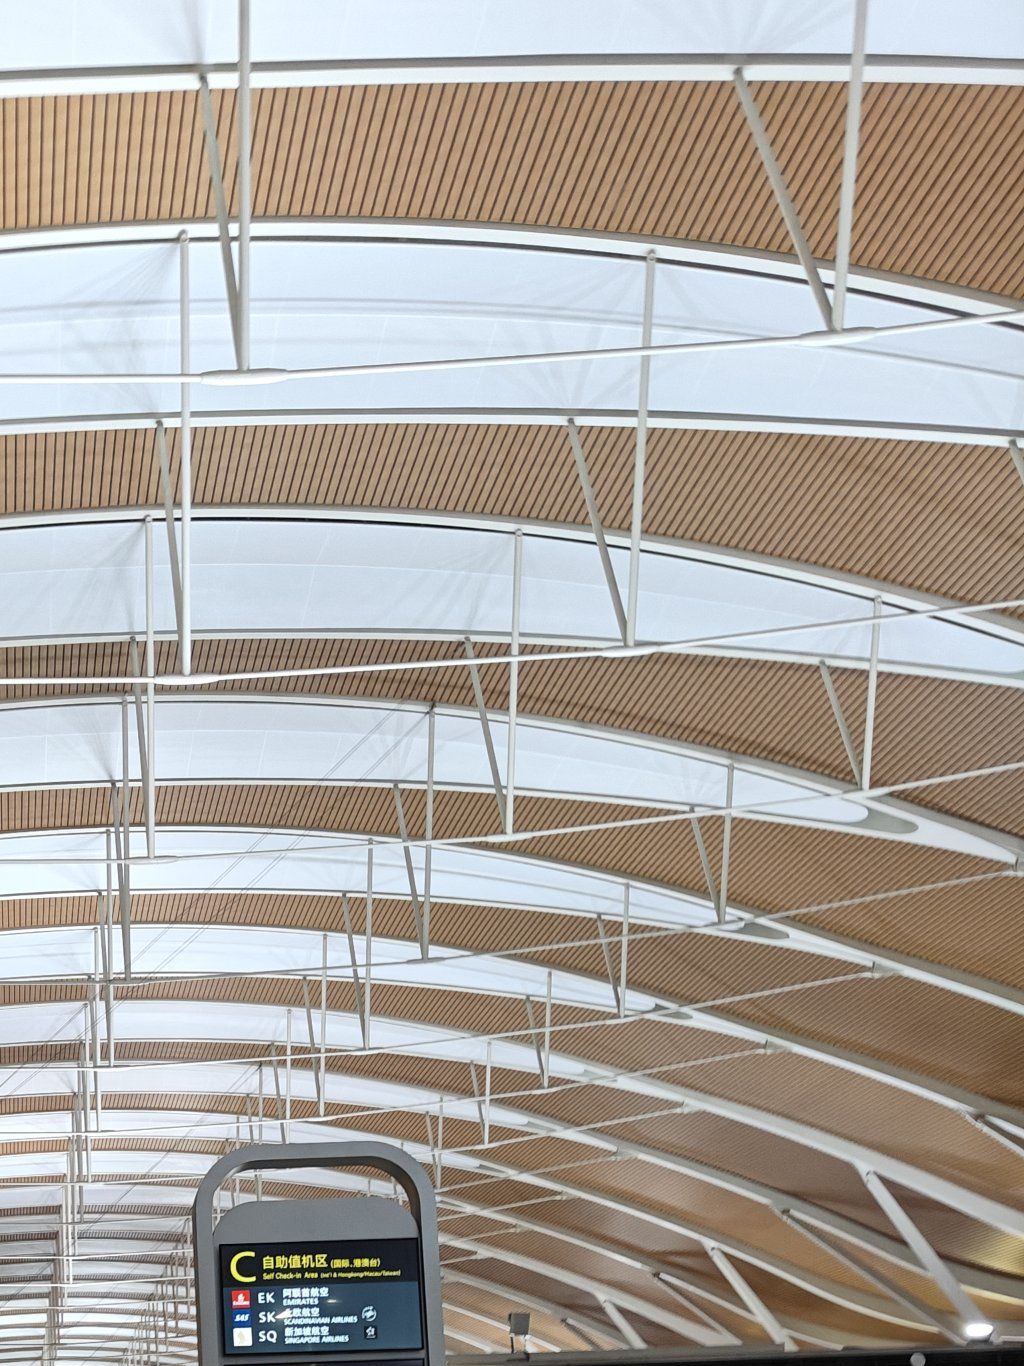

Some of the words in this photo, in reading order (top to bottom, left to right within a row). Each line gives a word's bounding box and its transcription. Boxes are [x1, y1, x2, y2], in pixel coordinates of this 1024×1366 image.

[230, 1251, 257, 1283] C
[262, 1254, 328, 1270] 自助值机区
[262, 1272, 275, 1280] Self
[275, 1271, 302, 1280] Check-in
[304, 1271, 319, 1279] Area
[258, 1291, 275, 1304] EK
[282, 1297, 319, 1306] EMIRATES
[234, 1313, 250, 1322] SAS
[258, 1311, 276, 1323] SK
[331, 1315, 358, 1324] AIRLINES
[258, 1330, 278, 1343] SQ
[284, 1336, 321, 1345] SINGAPORE
[321, 1335, 350, 1343] AIRLINES
